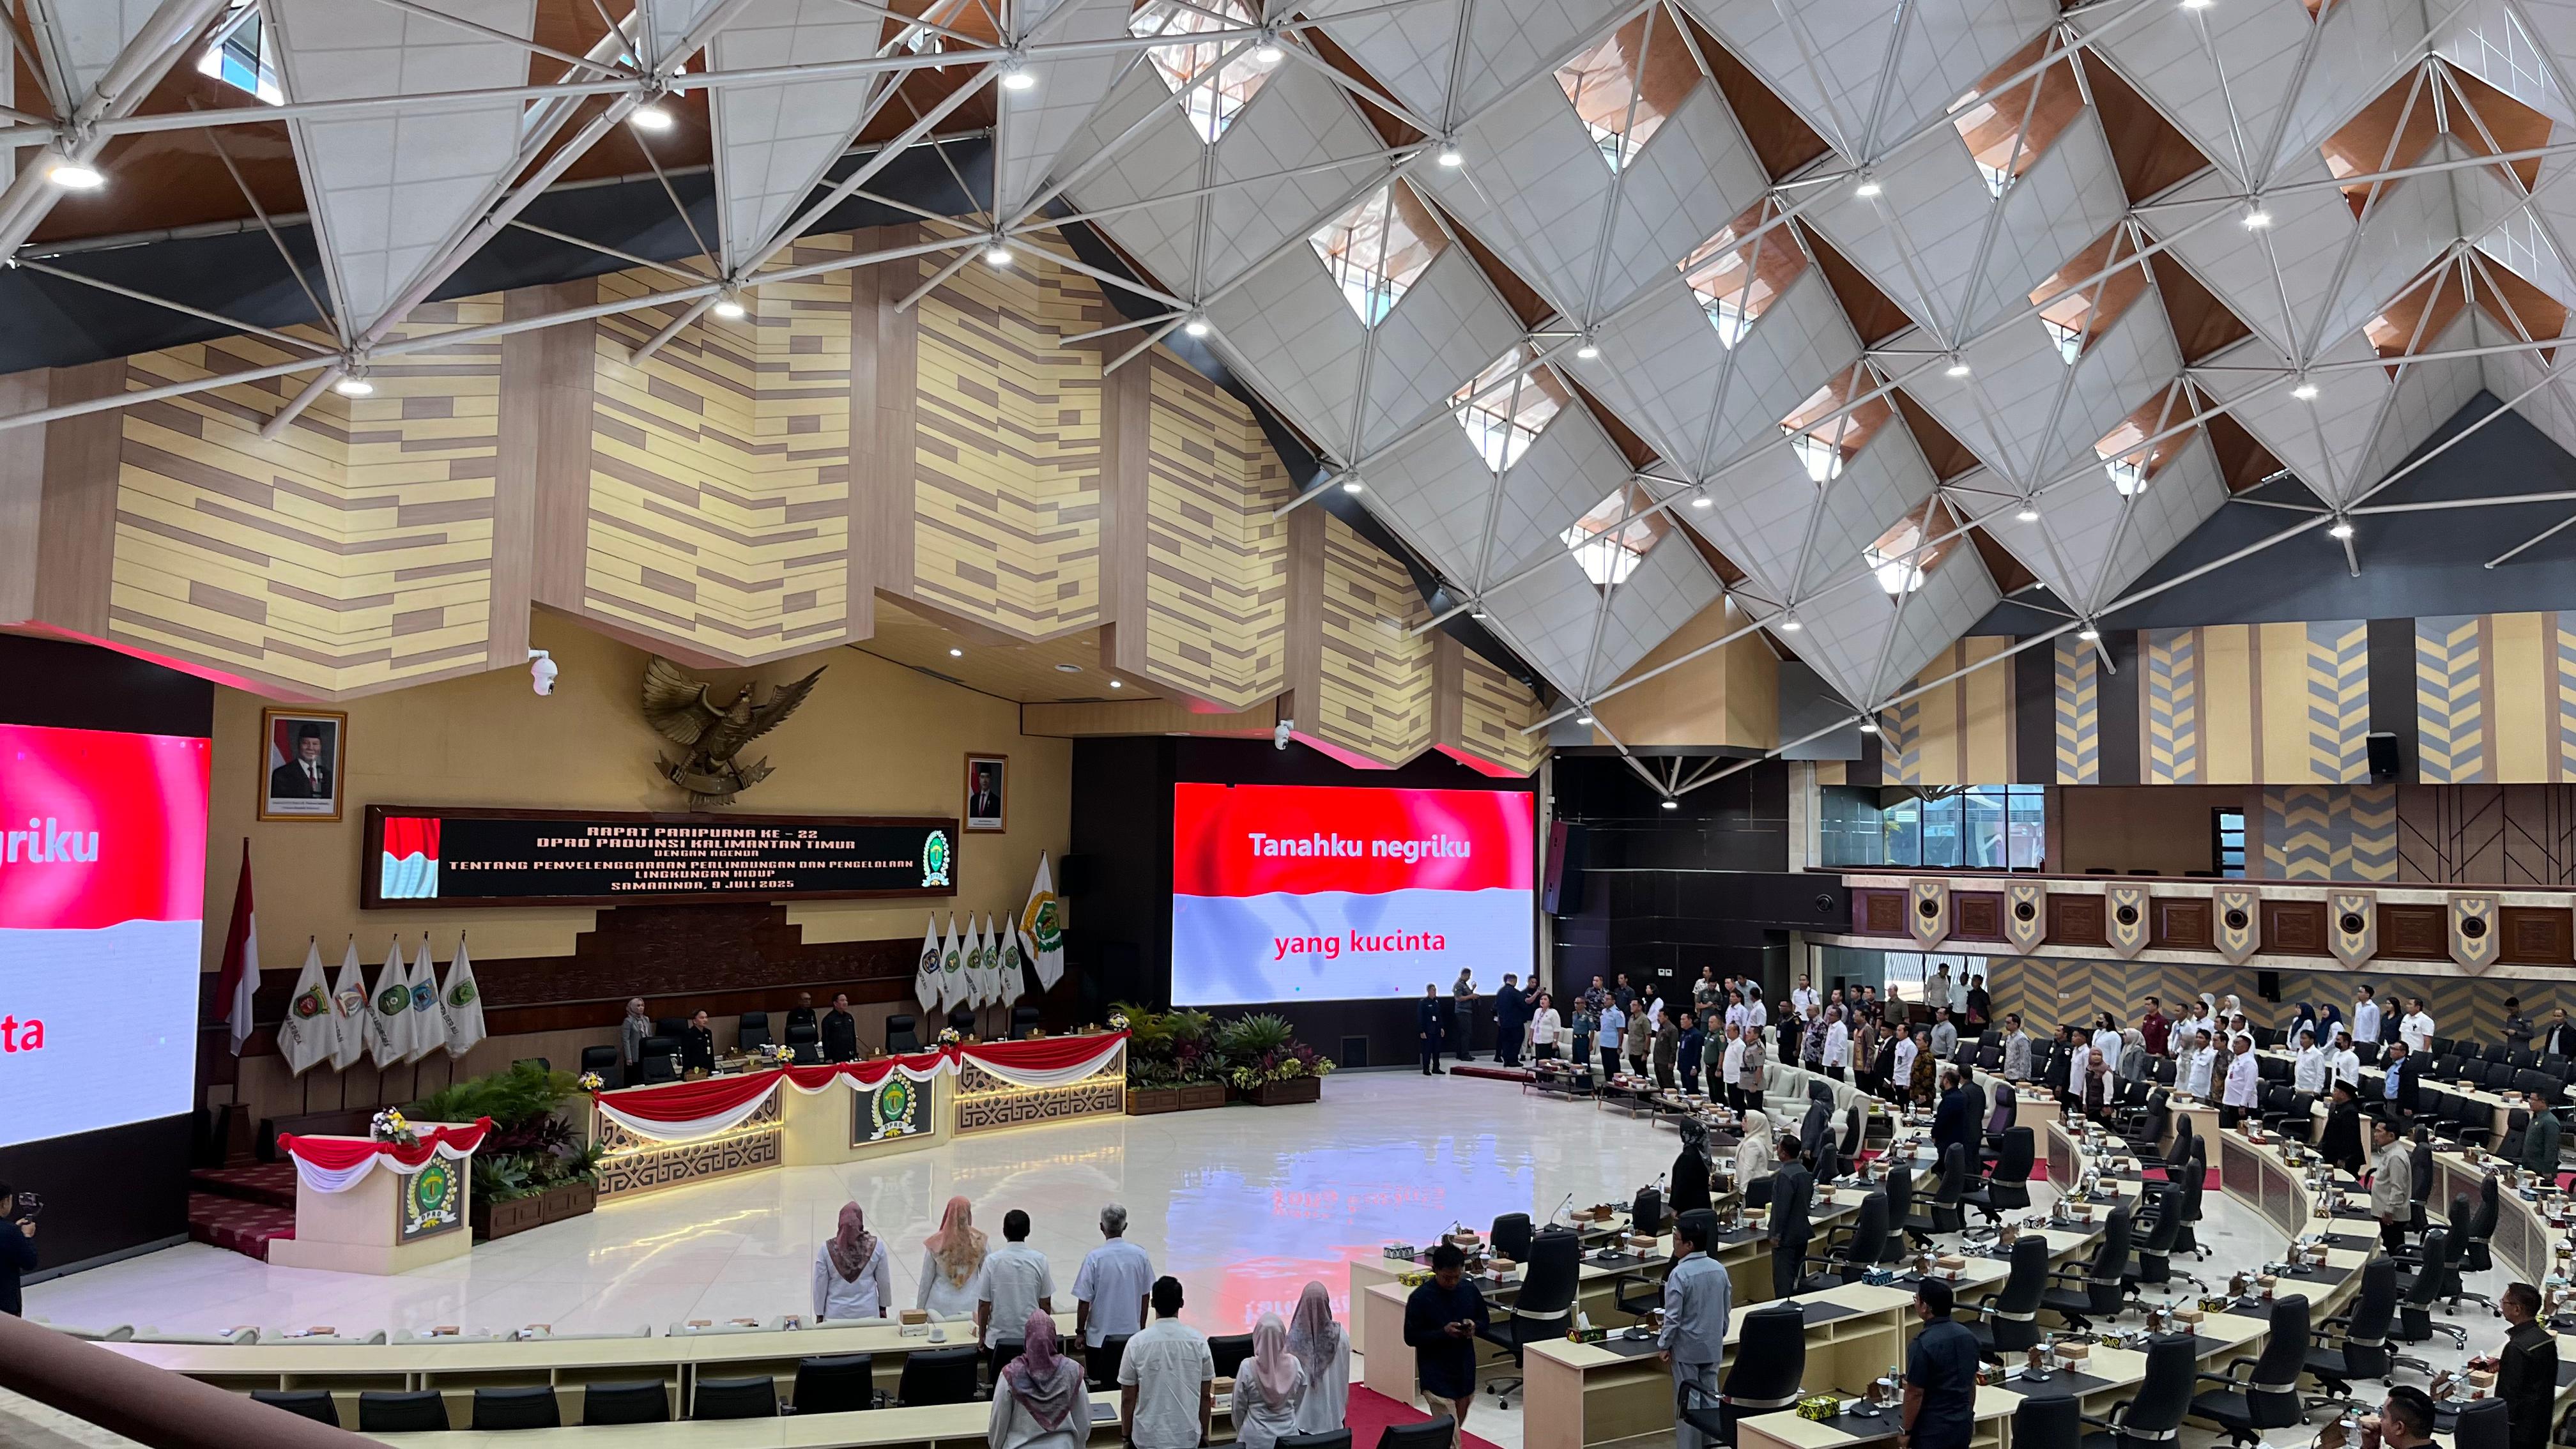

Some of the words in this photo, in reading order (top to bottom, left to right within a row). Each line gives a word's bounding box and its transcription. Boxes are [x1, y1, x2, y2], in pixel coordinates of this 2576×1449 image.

[586, 827, 650, 836] RAPAT
[654, 828, 756, 838] PARIPURNA
[761, 830, 780, 838] KE
[797, 830, 818, 839] 22
[0, 817, 99, 869] riku
[537, 838, 590, 848] DPRD
[596, 838, 686, 848] PROVINSI
[691, 839, 801, 849] KALIMANTAN
[806, 840, 855, 849] TIMUR
[1248, 832, 1363, 857] Tanahku
[1372, 834, 1471, 864] negriku
[449, 861, 528, 870] TENTANG
[533, 861, 686, 870] PENYELENGGARAAN
[635, 870, 730, 879] LINGKUNGAN
[733, 870, 775, 878] HIDUP
[611, 881, 707, 891] SAMARINDA,
[724, 880, 756, 889] JULI
[1274, 935, 1340, 961] yang
[1350, 929, 1446, 952] kucinta
[0, 1013, 45, 1054] ta
[884, 1122, 903, 1130] DPRD
[421, 1211, 441, 1221] DPRD
